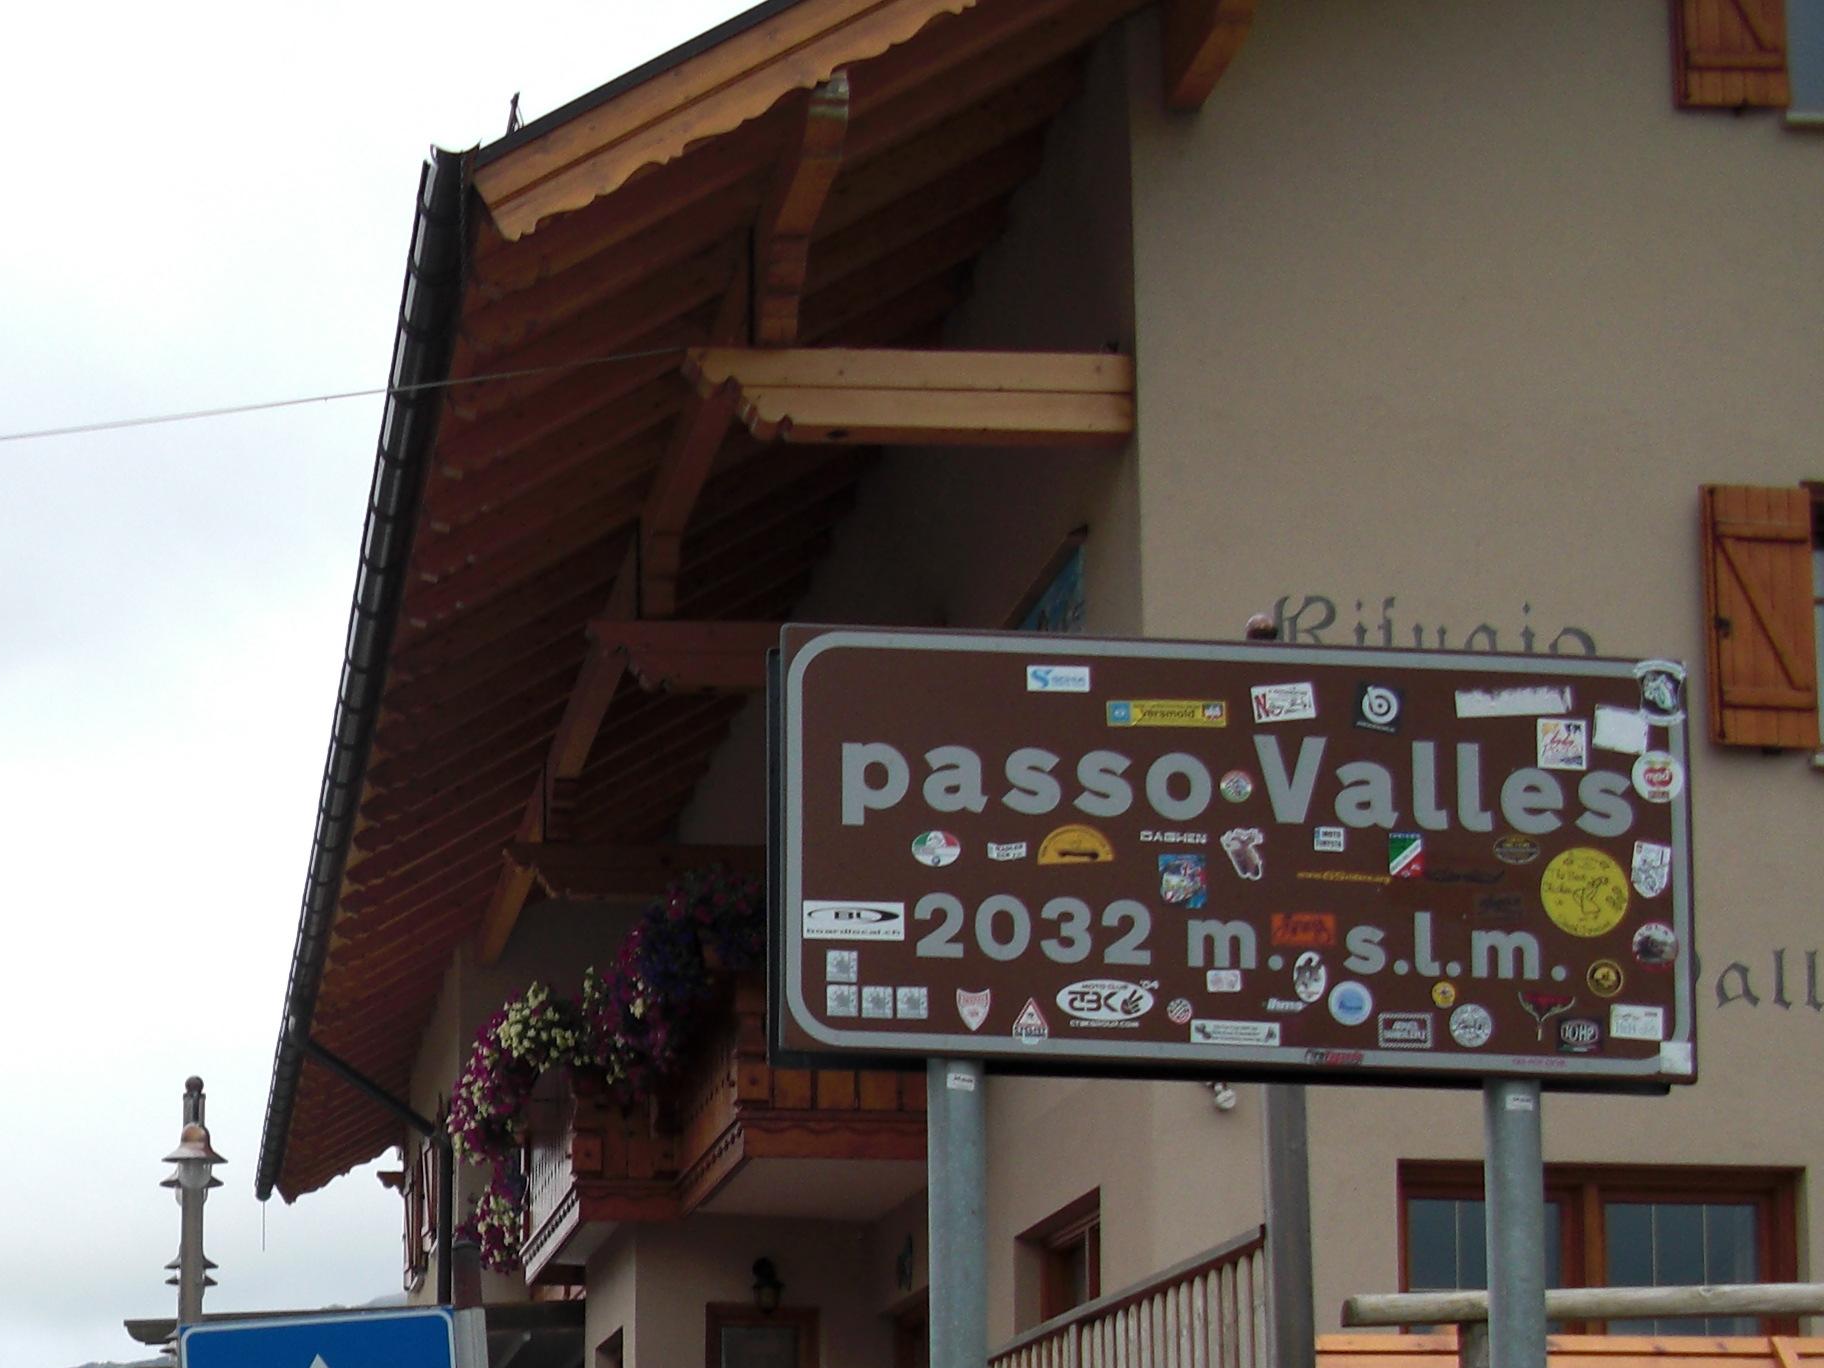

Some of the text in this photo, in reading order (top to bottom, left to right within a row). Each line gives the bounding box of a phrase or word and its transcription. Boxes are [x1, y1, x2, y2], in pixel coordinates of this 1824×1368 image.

[842, 734, 1633, 837] passo Valles
[913, 892, 1152, 966] 2032
[1187, 918, 1284, 971] m.
[1343, 911, 1568, 982] s.l.m.
